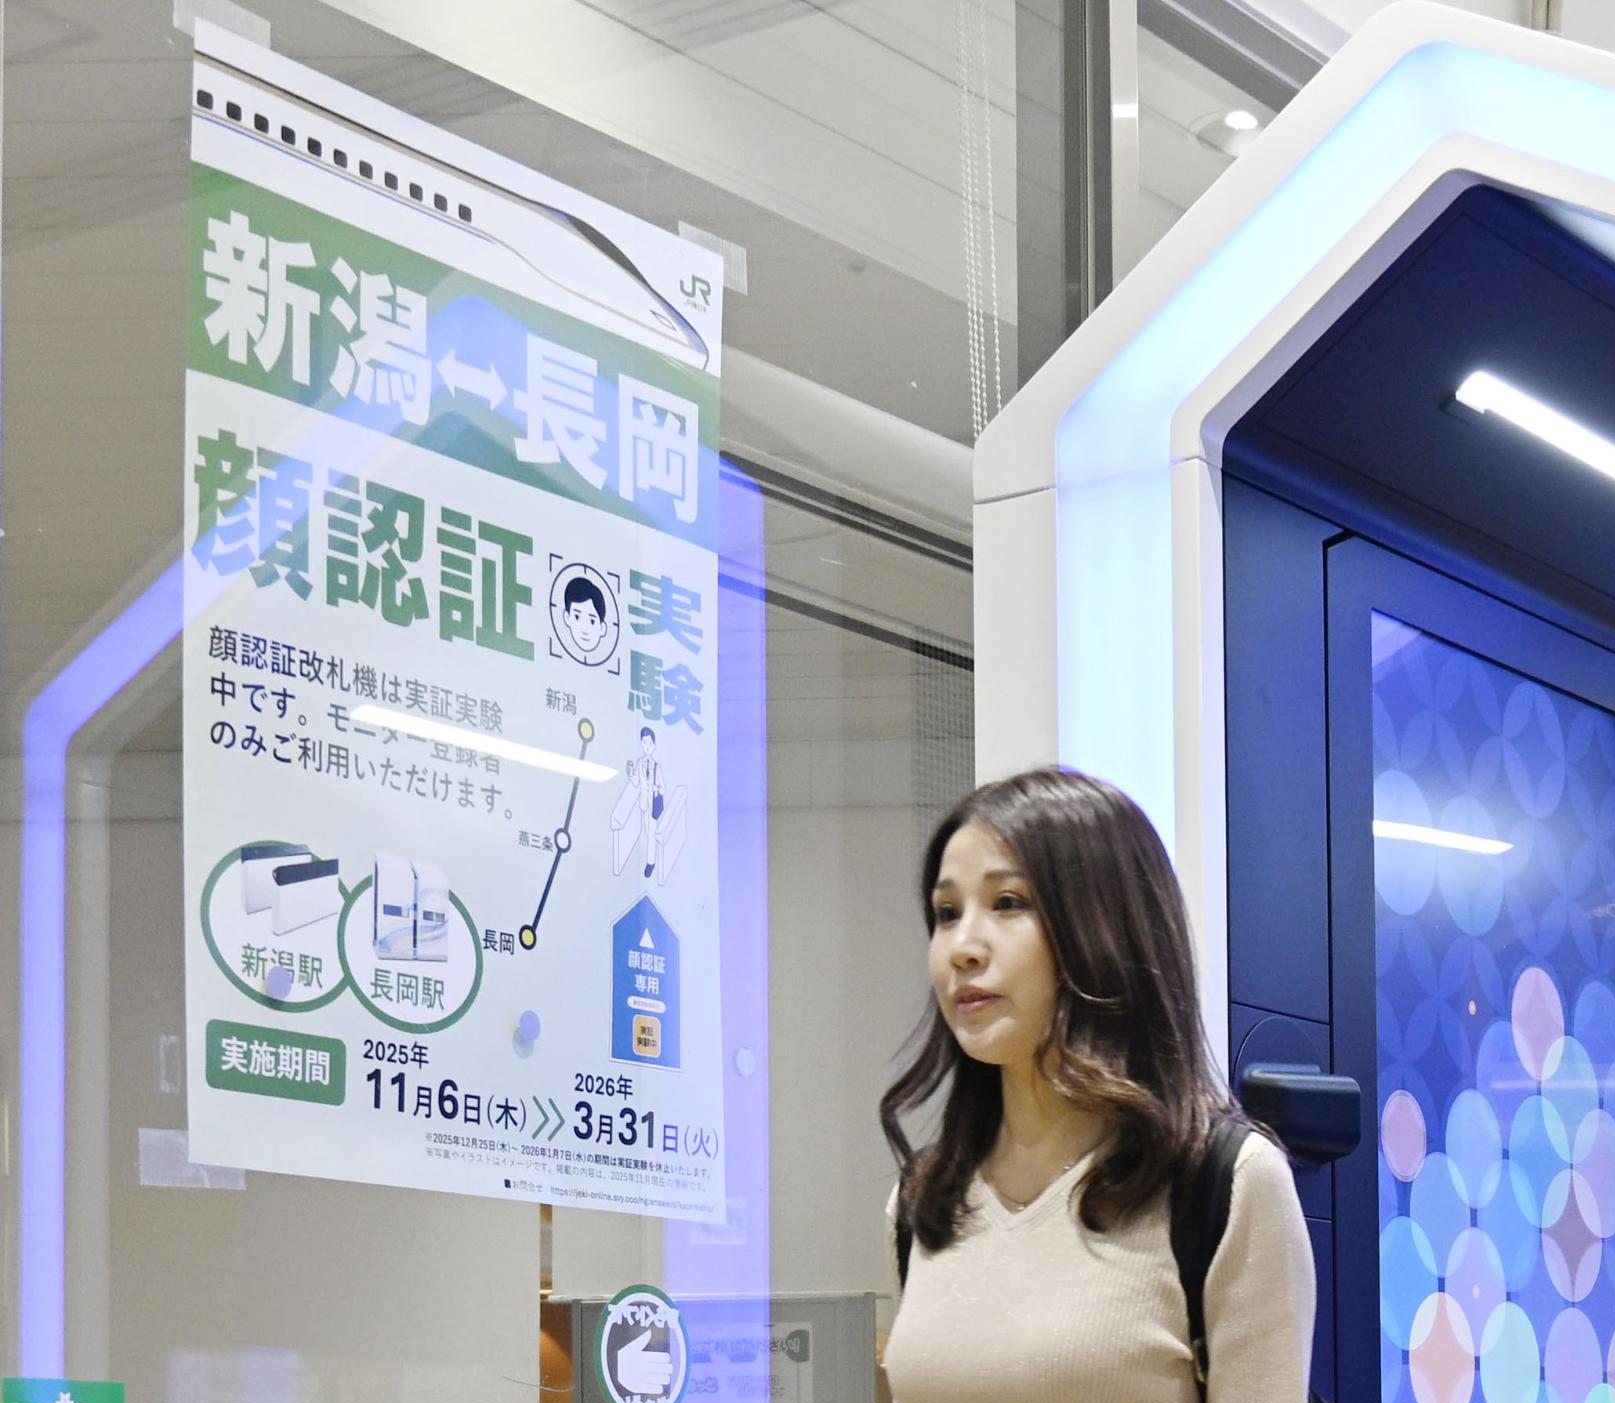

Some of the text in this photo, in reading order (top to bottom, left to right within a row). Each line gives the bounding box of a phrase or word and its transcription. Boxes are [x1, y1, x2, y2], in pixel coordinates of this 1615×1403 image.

[680, 274, 711, 306] JR
[203, 211, 700, 524] 新潟 長岡
[190, 429, 535, 662] 顔認証
[627, 569, 704, 736] 実験
[209, 625, 504, 735] 顔認証改札機は実証実験
[545, 687, 577, 716] 新潟
[210, 720, 513, 821] のみご利用いただけます。
[482, 929, 515, 955] 長岡
[370, 967, 445, 1010] 長岡駅
[221, 1036, 330, 1086] 実施期間
[363, 1039, 430, 1070] 2025年
[574, 1072, 633, 1100] 2026年
